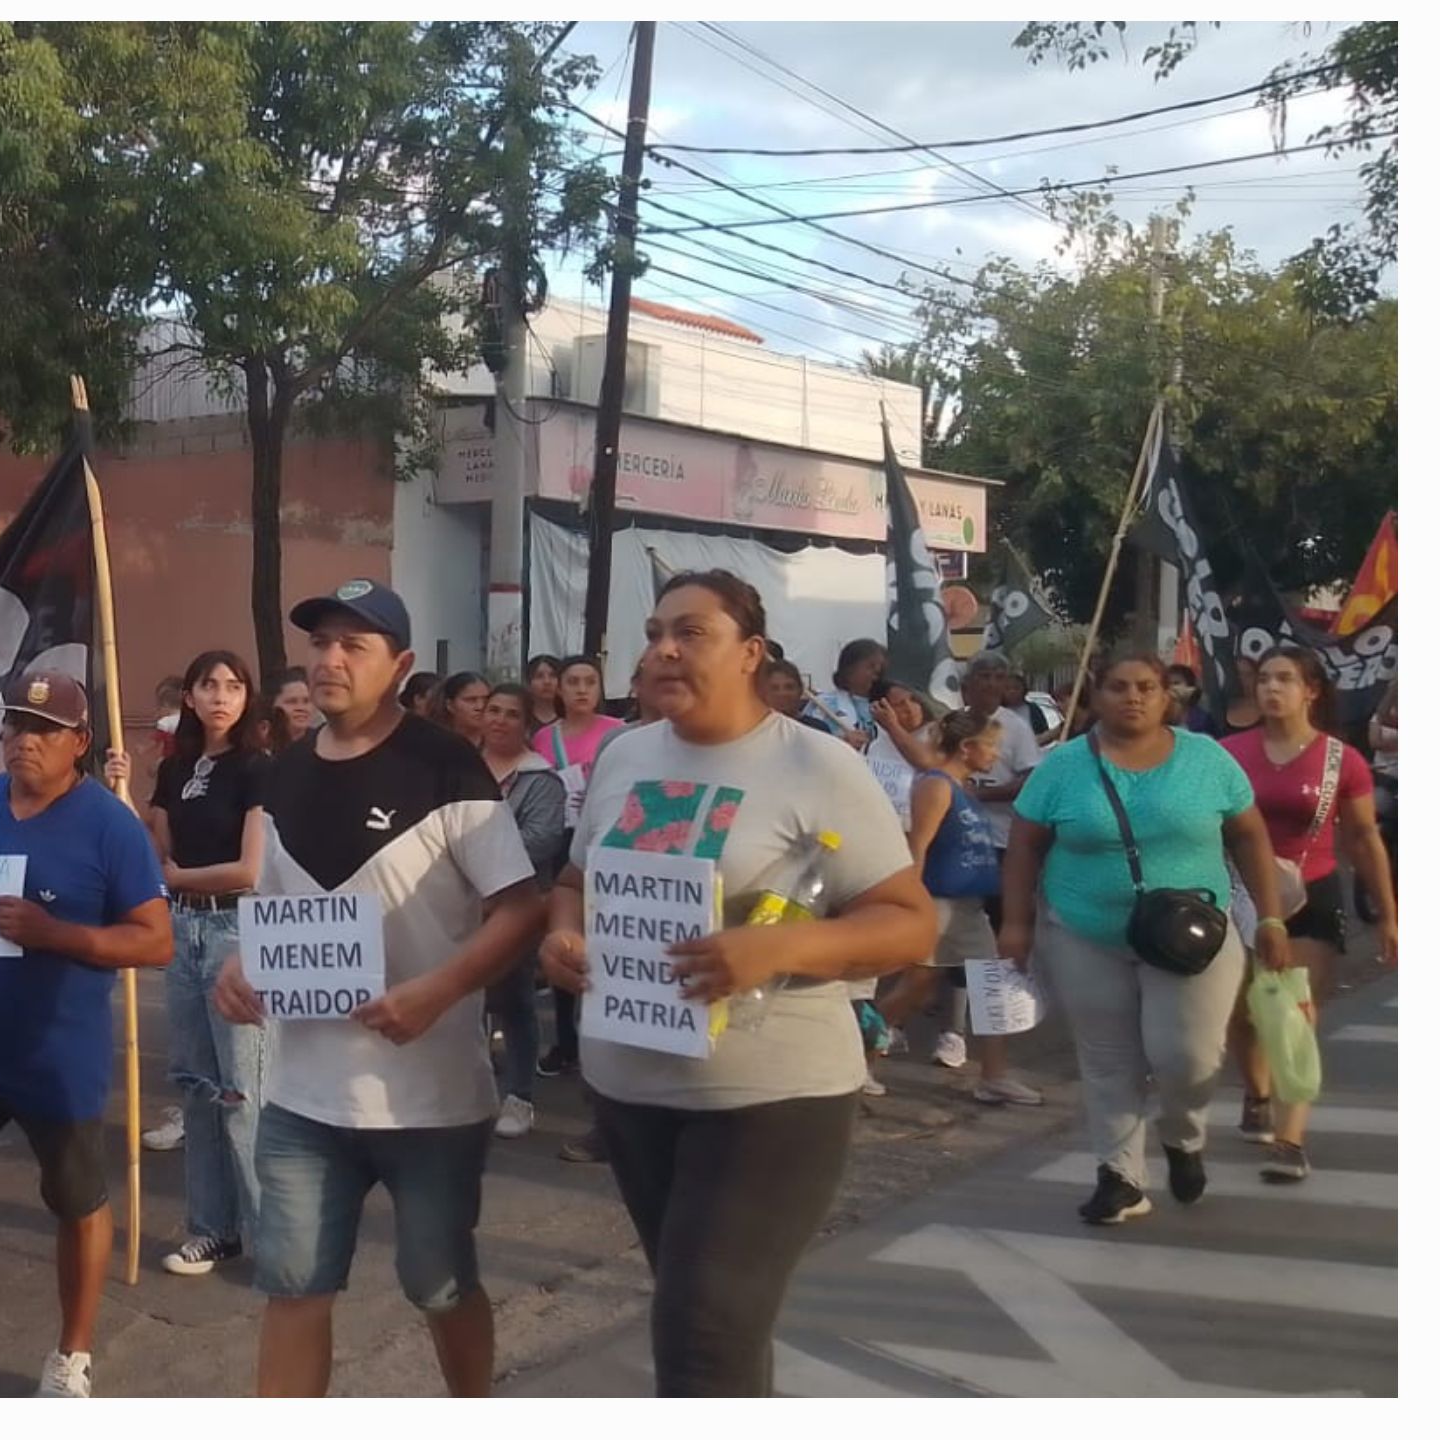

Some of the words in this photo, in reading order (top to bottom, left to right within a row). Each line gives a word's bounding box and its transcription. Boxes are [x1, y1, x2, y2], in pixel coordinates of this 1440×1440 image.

[616, 450, 686, 481] ERCERÍA
[593, 870, 704, 906] MARTIN
[253, 895, 358, 926] MARTIN
[594, 912, 703, 945] MENEM
[260, 942, 362, 971] MENEM
[604, 994, 697, 1033] PATRIA
